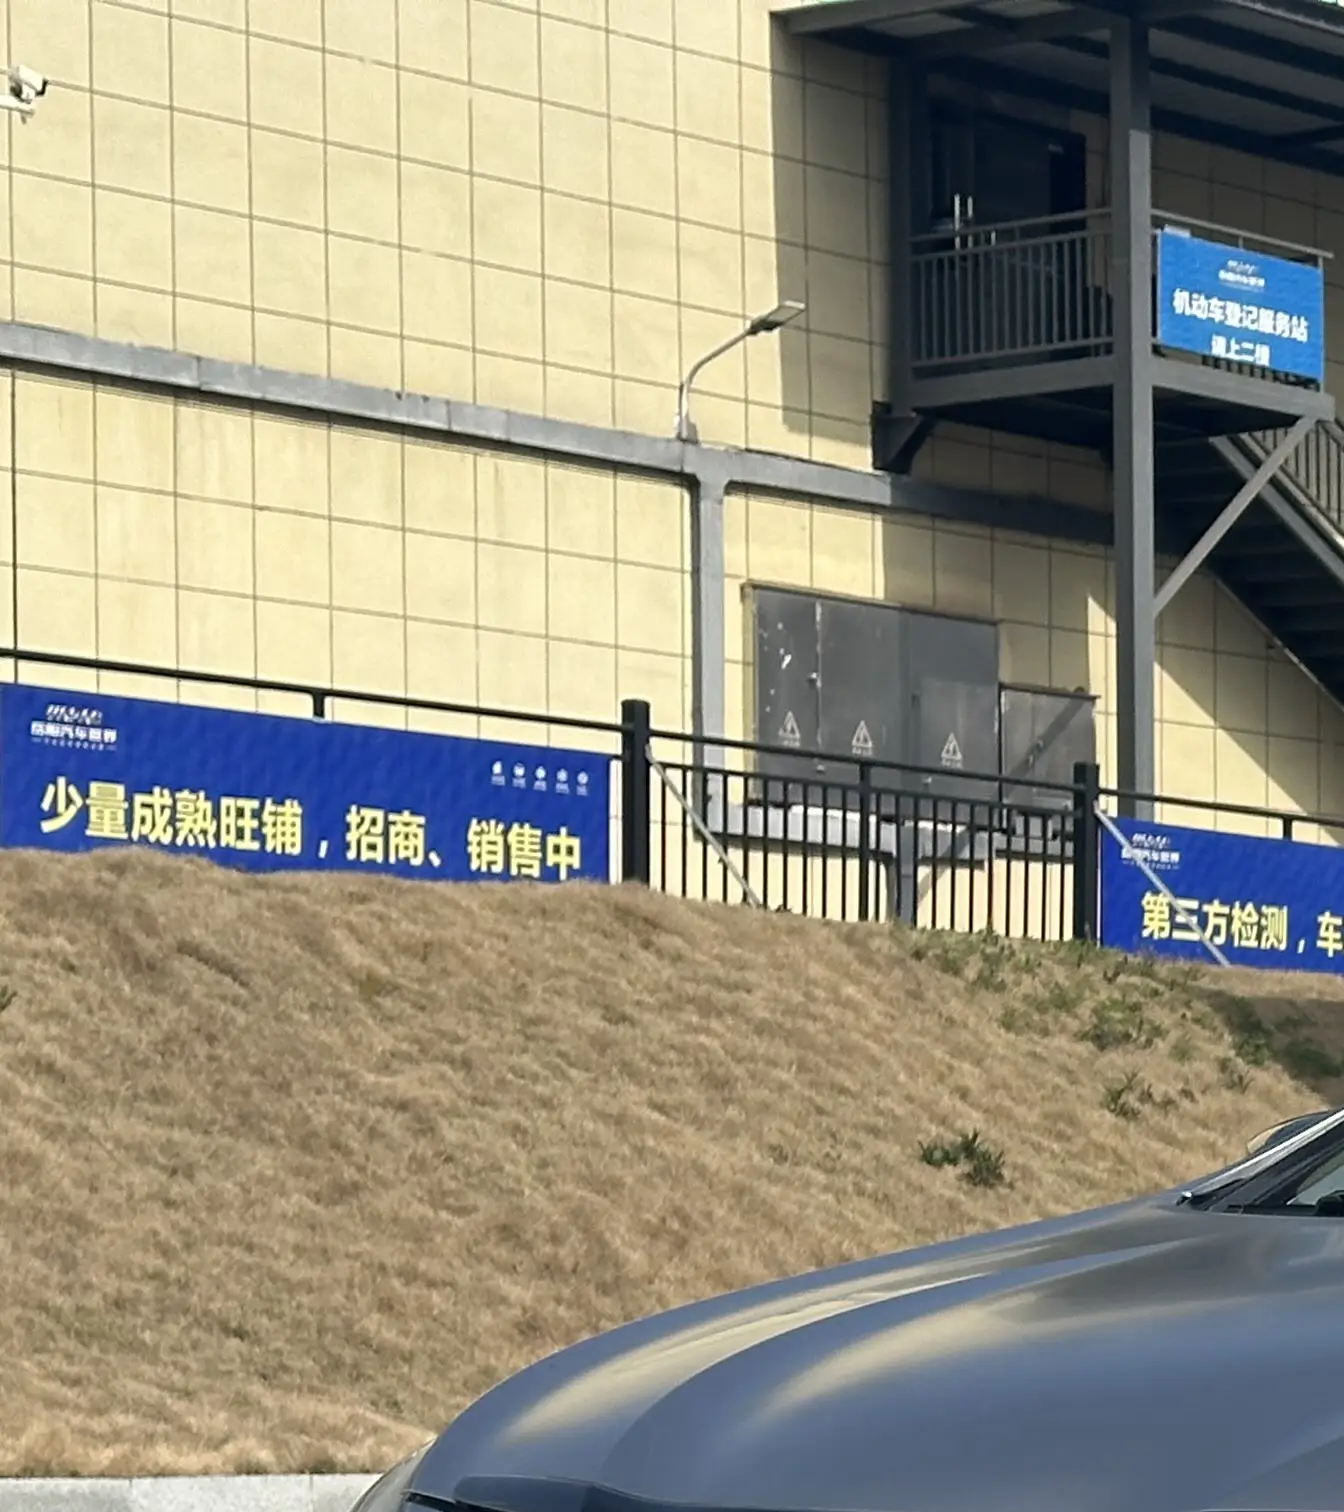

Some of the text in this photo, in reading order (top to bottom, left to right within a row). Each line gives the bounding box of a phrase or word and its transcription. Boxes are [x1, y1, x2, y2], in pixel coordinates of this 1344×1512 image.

[1173, 288, 1309, 343] 机动车登记服务站
